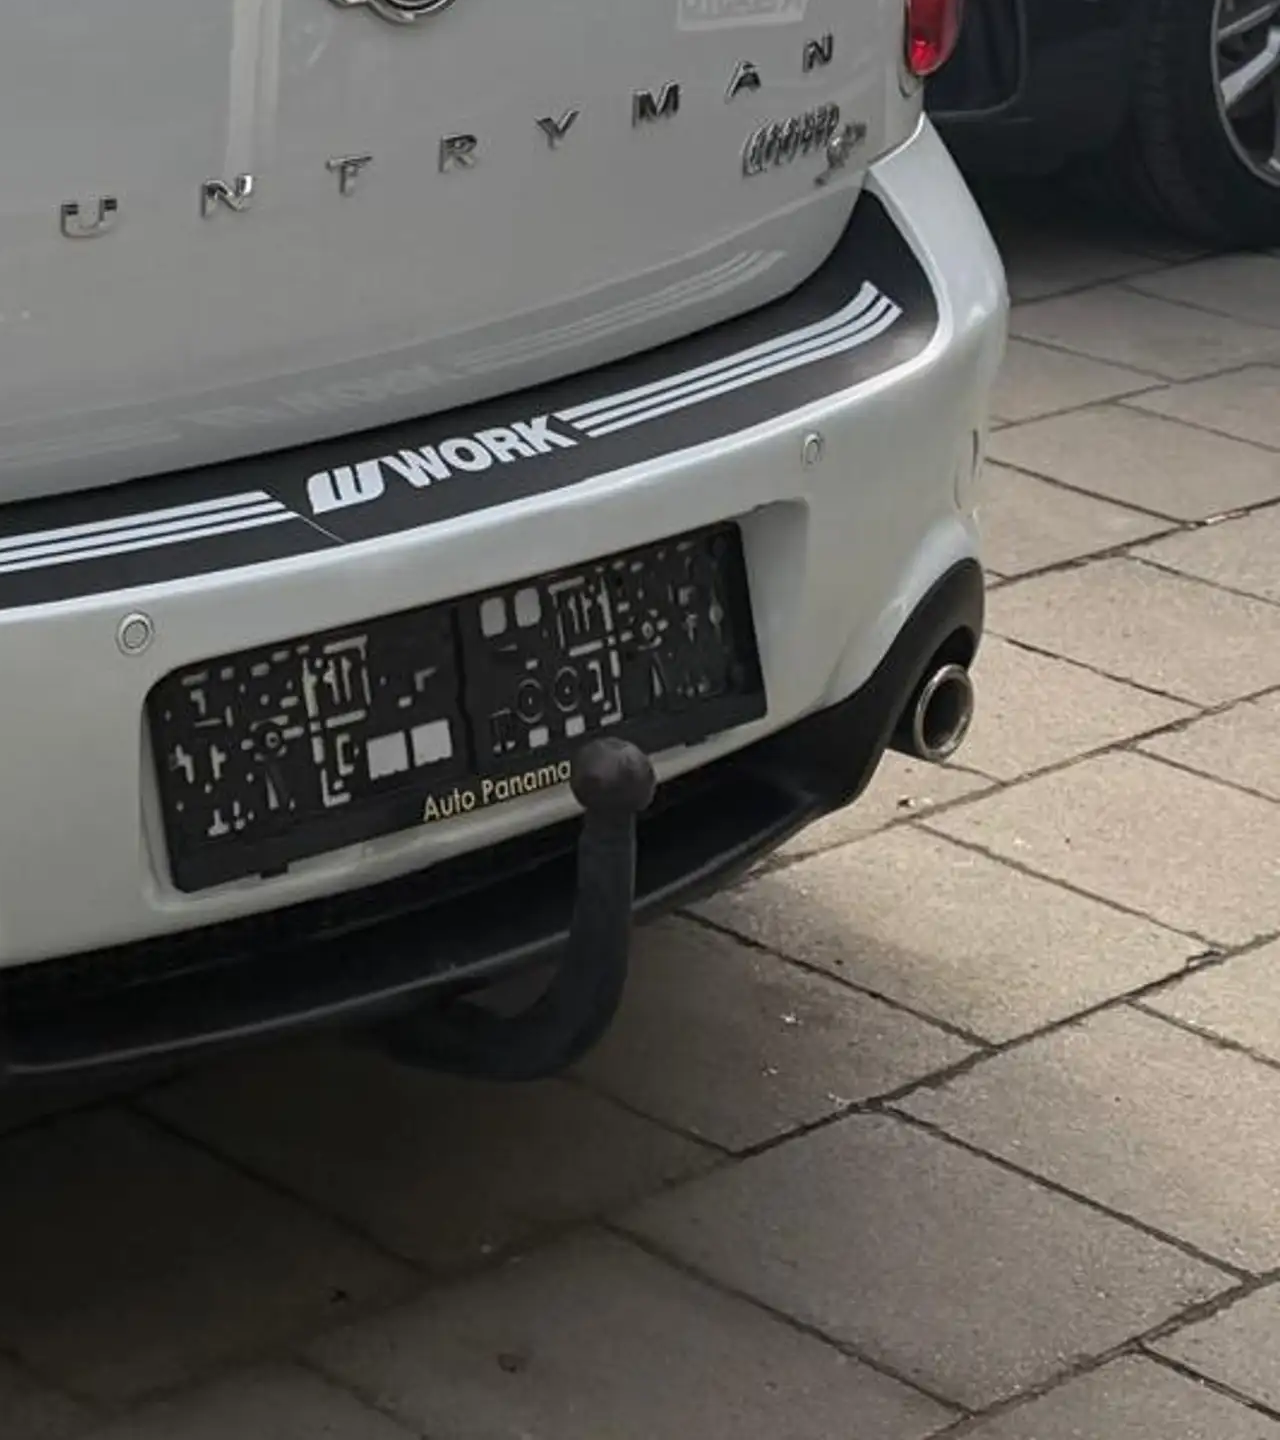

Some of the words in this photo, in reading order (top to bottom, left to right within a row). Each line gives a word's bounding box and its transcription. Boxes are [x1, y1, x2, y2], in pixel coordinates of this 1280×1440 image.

[376, 413, 580, 489] WORK
[424, 787, 476, 822] Auto
[481, 759, 572, 805] Panama
